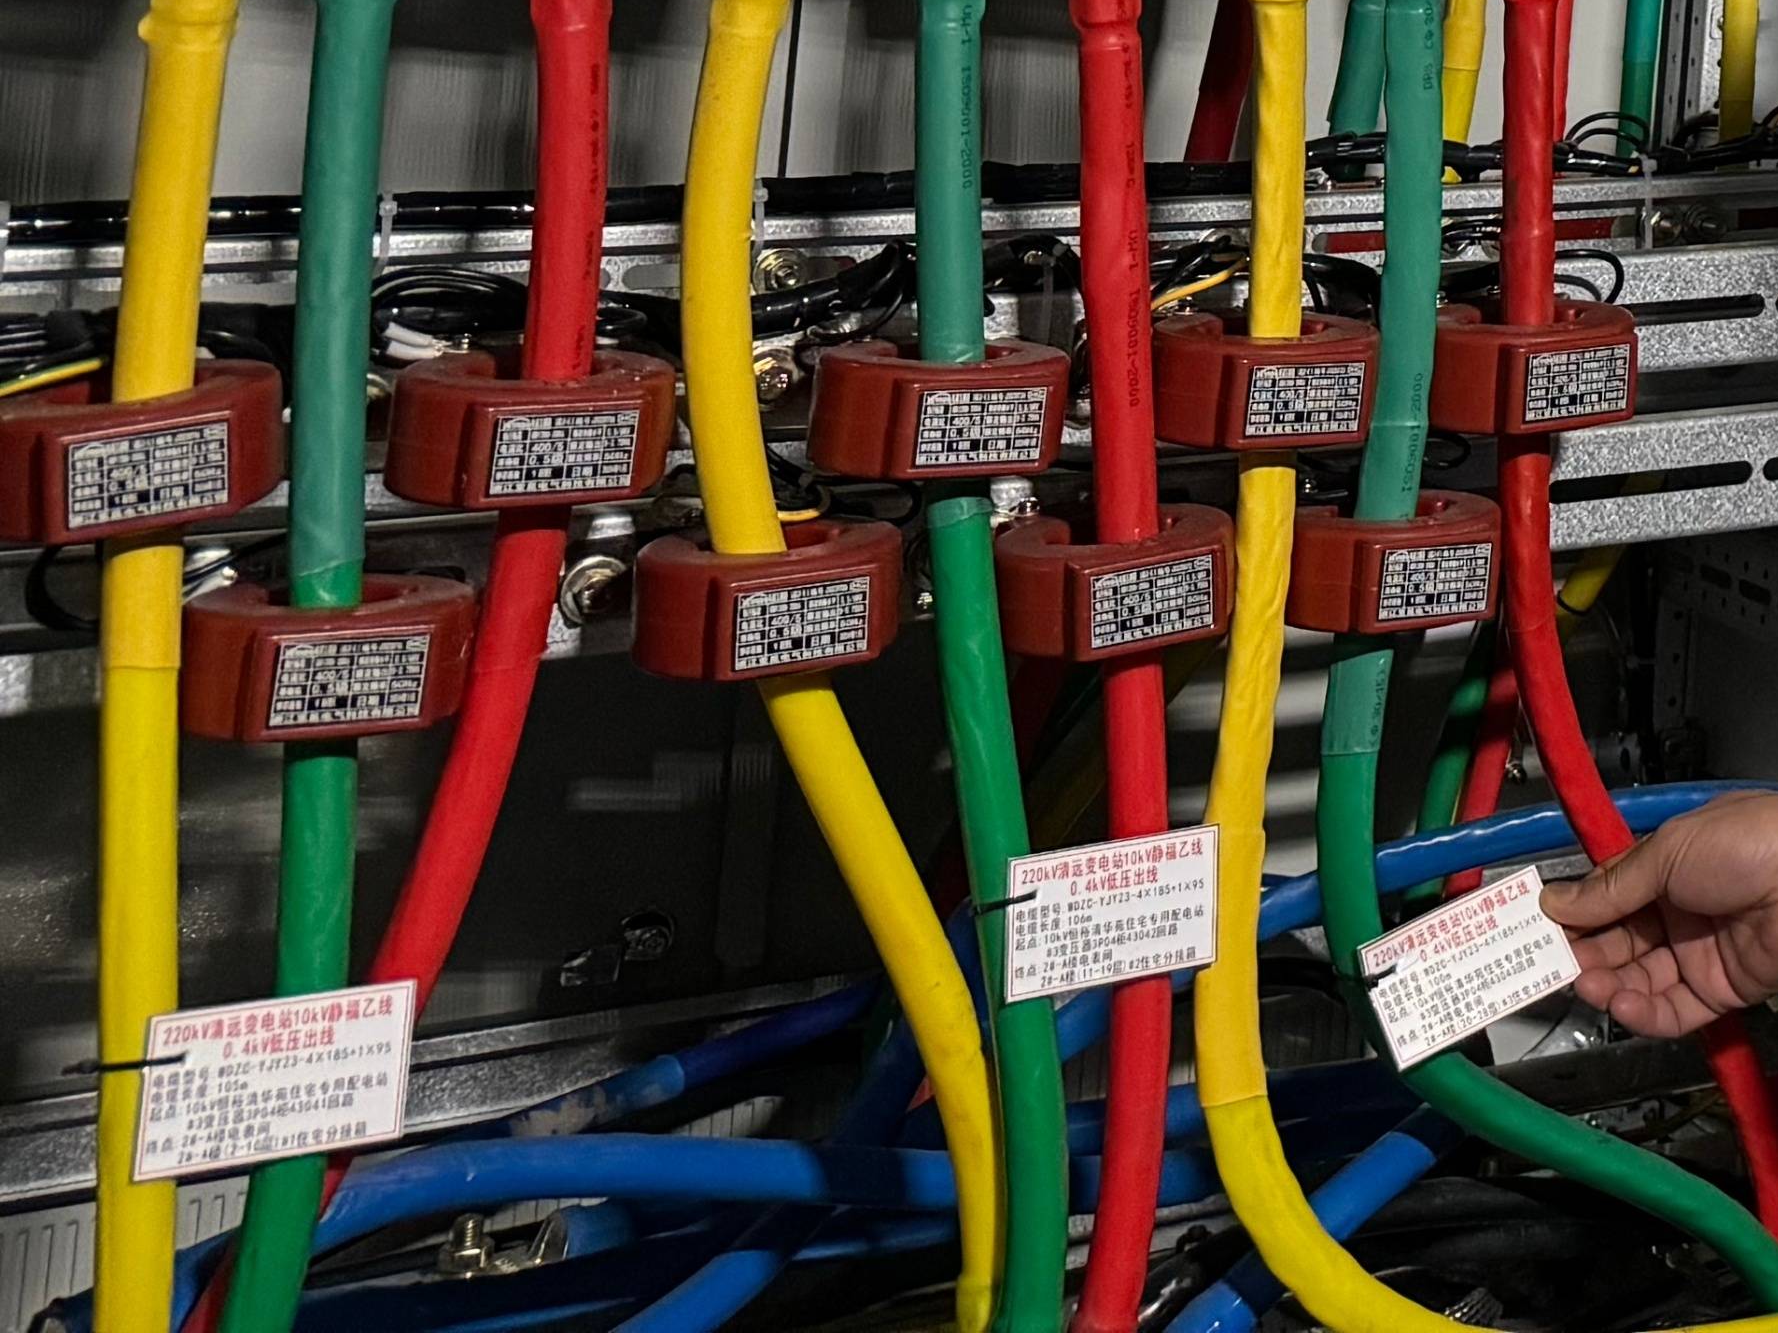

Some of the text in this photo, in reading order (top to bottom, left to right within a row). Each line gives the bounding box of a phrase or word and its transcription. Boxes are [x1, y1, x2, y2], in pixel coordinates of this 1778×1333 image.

[960, 66, 973, 190] ISO9001-2000
[530, 442, 564, 453] 400/5
[1401, 373, 1424, 493] ISO9001-2000
[1122, 594, 1151, 605] 400/5
[1070, 866, 1159, 896] 0.4kV低压出线
[1419, 914, 1500, 963] 0.4kV低压出线
[222, 1027, 336, 1059] 0.4kV低压出线
